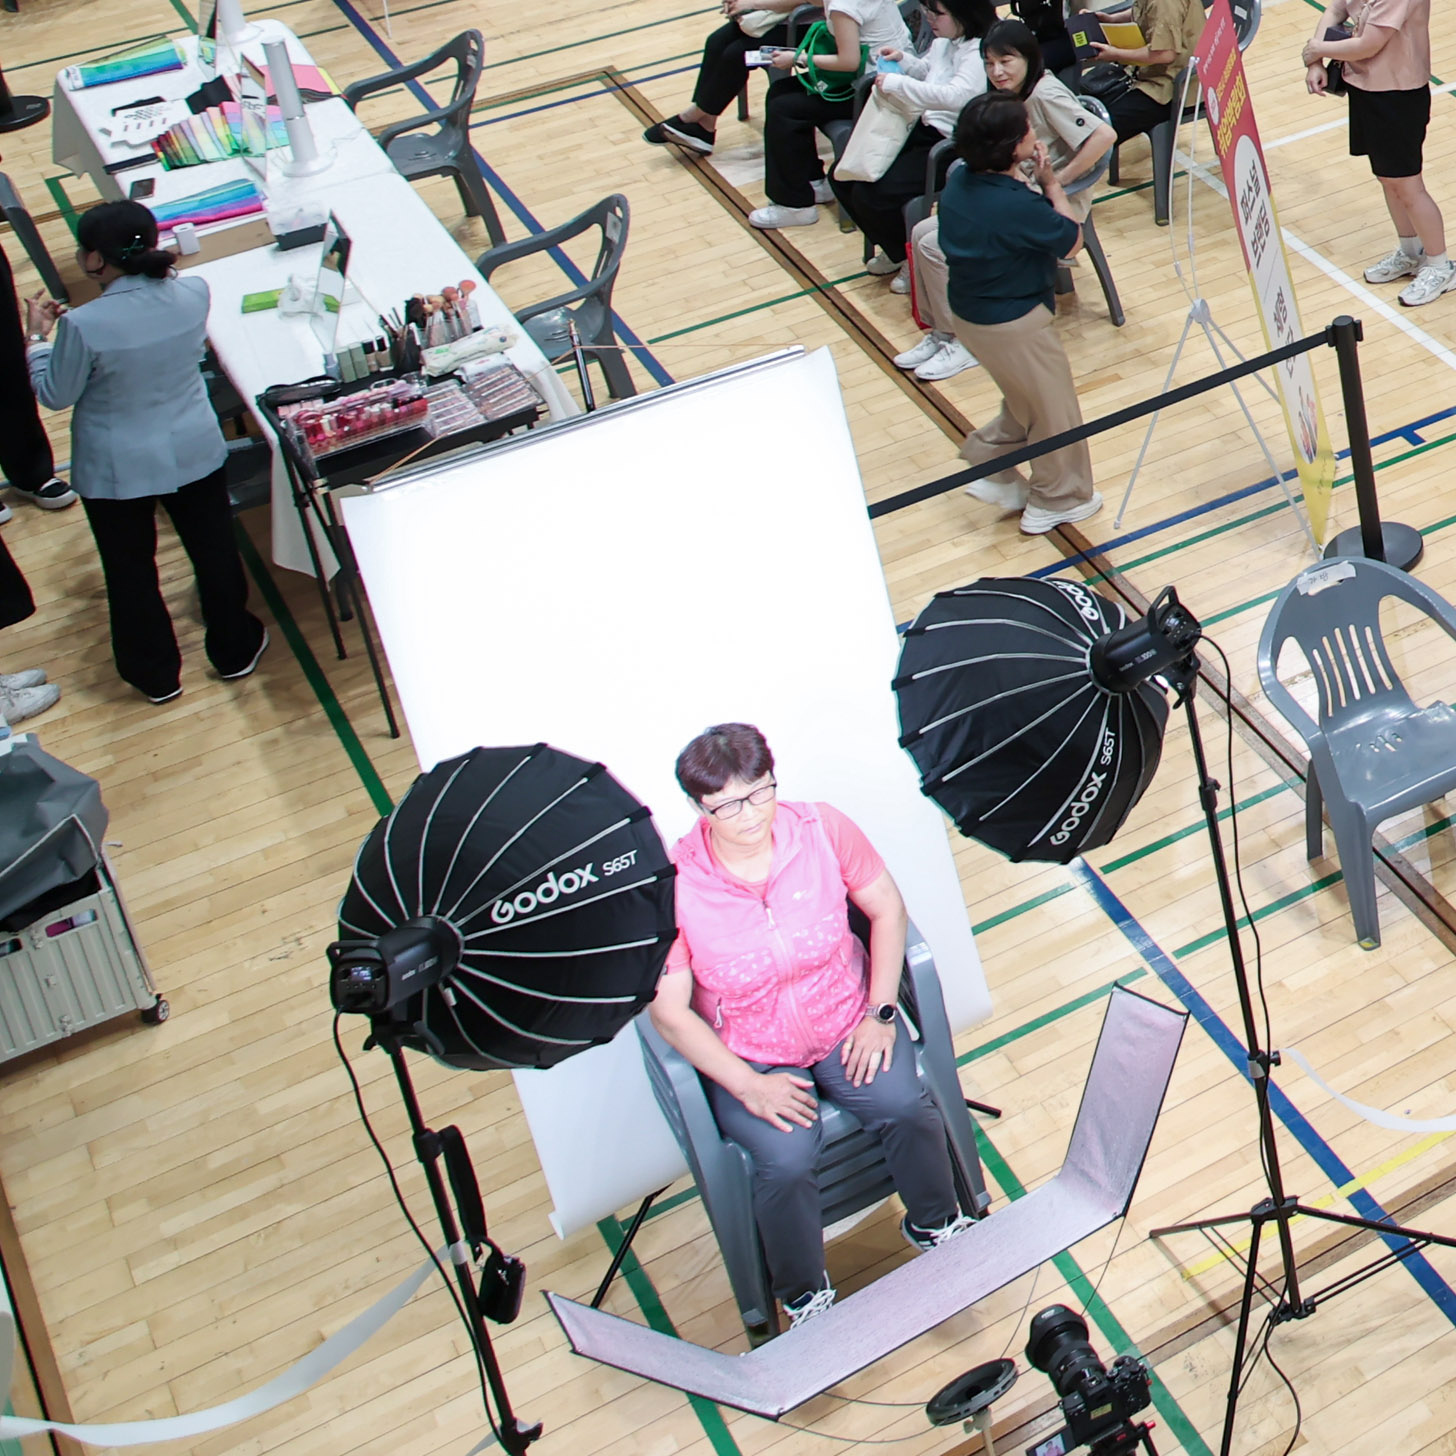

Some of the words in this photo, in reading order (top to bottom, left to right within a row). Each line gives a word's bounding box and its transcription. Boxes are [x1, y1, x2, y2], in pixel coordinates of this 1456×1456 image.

[1240, 159, 1261, 225] 퍼스널
[1251, 200, 1271, 268] 브랜딩
[1050, 771, 1107, 846] Godox
[1101, 728, 1116, 766] S65T
[490, 862, 600, 924] Godox
[602, 849, 638, 876] S65T
